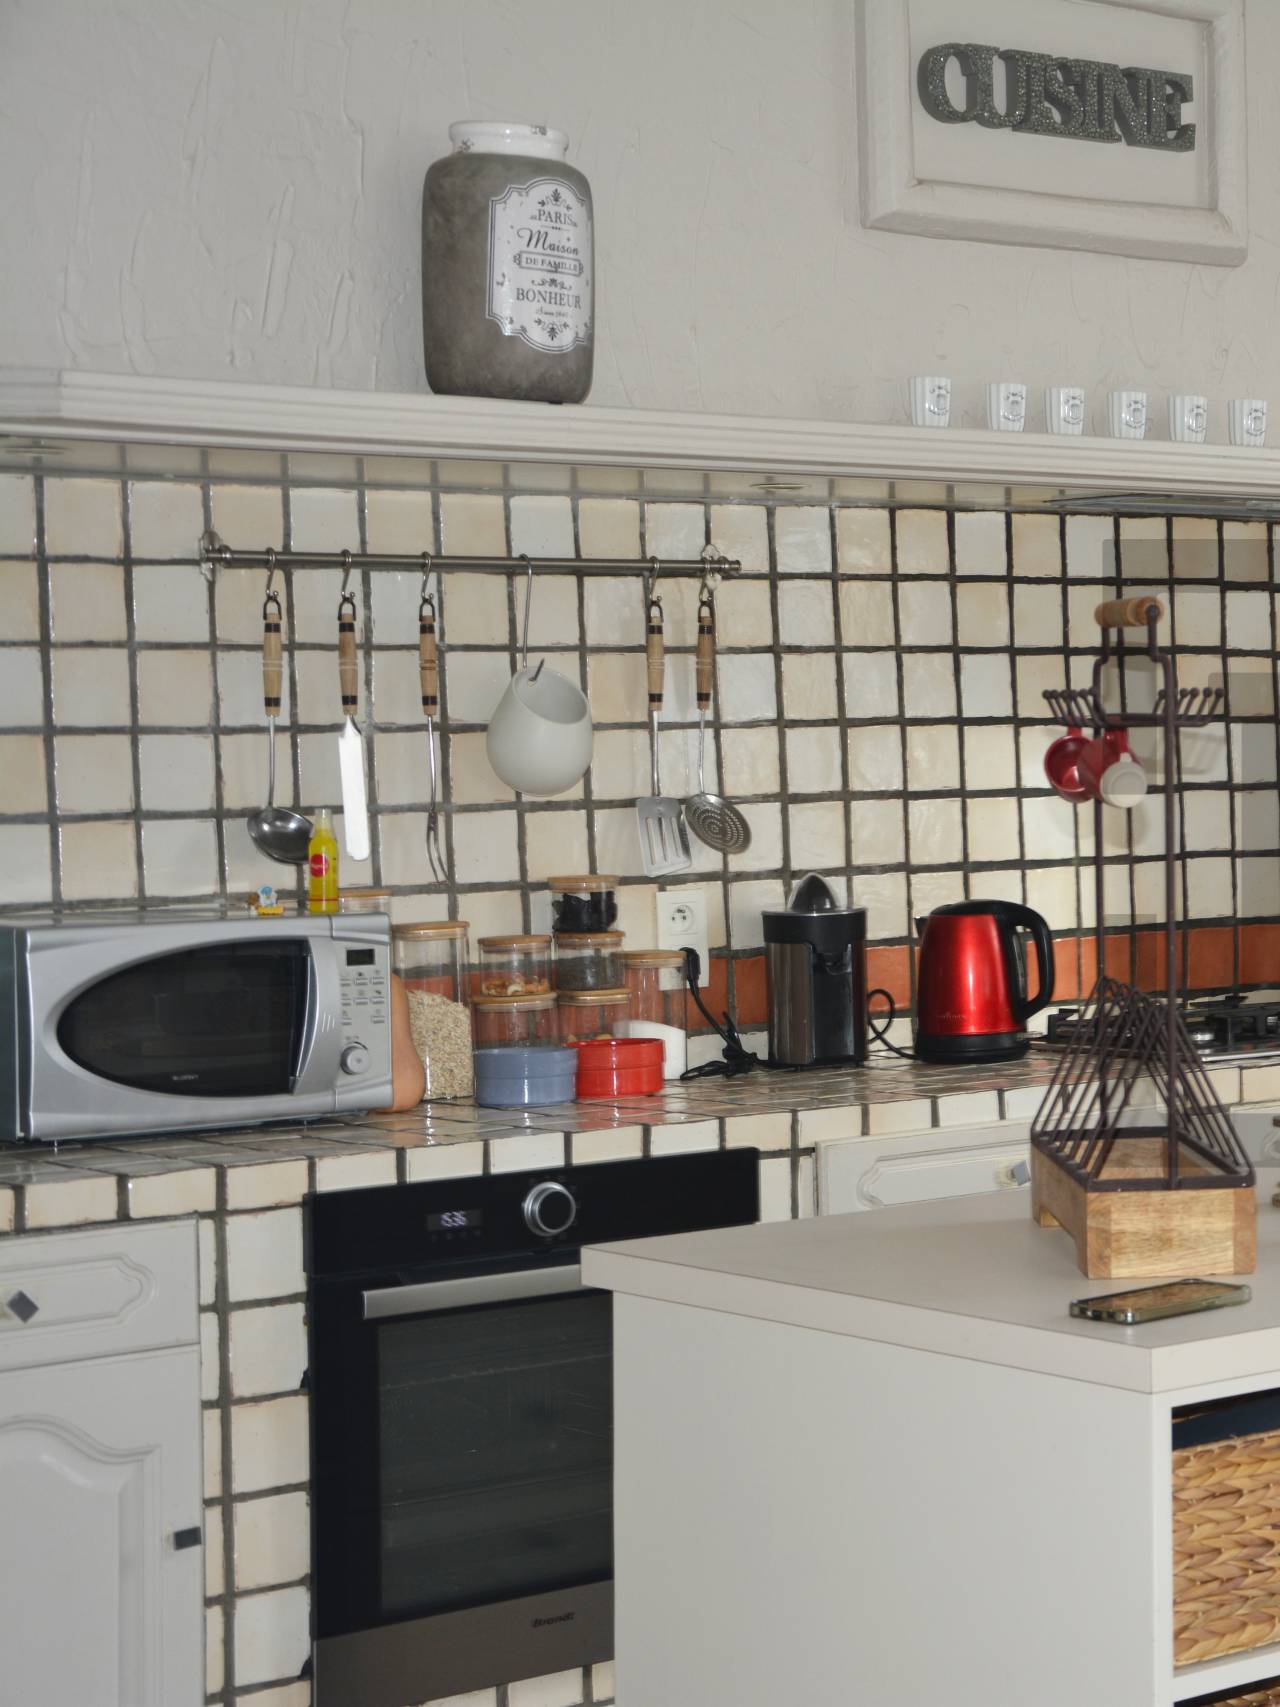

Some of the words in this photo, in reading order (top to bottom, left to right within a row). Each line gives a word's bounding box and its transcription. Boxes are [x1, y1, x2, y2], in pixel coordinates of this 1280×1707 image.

[917, 43, 1196, 152] CUISINE
[537, 209, 573, 226] PARIS
[516, 227, 579, 256] Maison
[525, 256, 538, 266] DE
[541, 258, 578, 273] FAMILLE
[516, 287, 582, 310] BONHEUR
